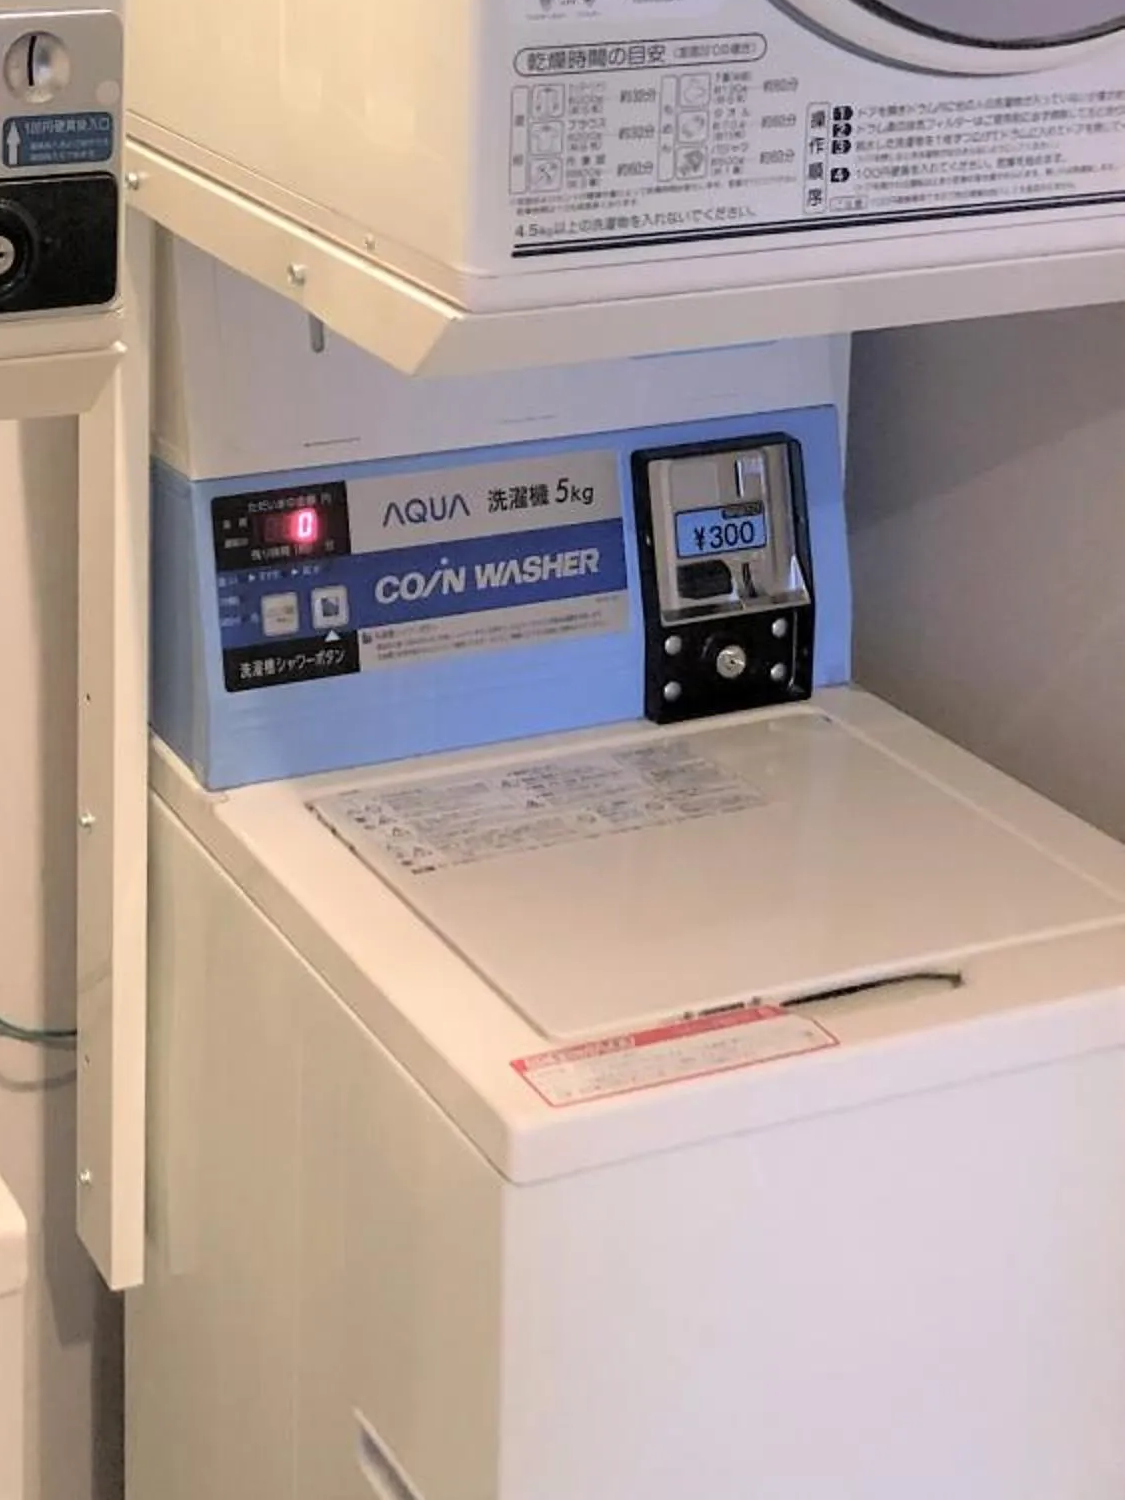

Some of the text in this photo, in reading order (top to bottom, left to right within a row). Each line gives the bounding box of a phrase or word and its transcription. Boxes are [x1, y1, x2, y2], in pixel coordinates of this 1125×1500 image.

[528, 45, 666, 71] 乾燥時間の目安
[382, 493, 471, 527] AQUA
[487, 477, 595, 514] 洗濯機 5kg
[297, 510, 313, 538] 0
[693, 520, 754, 551] ¥300
[375, 547, 600, 604] COIN WASHER
